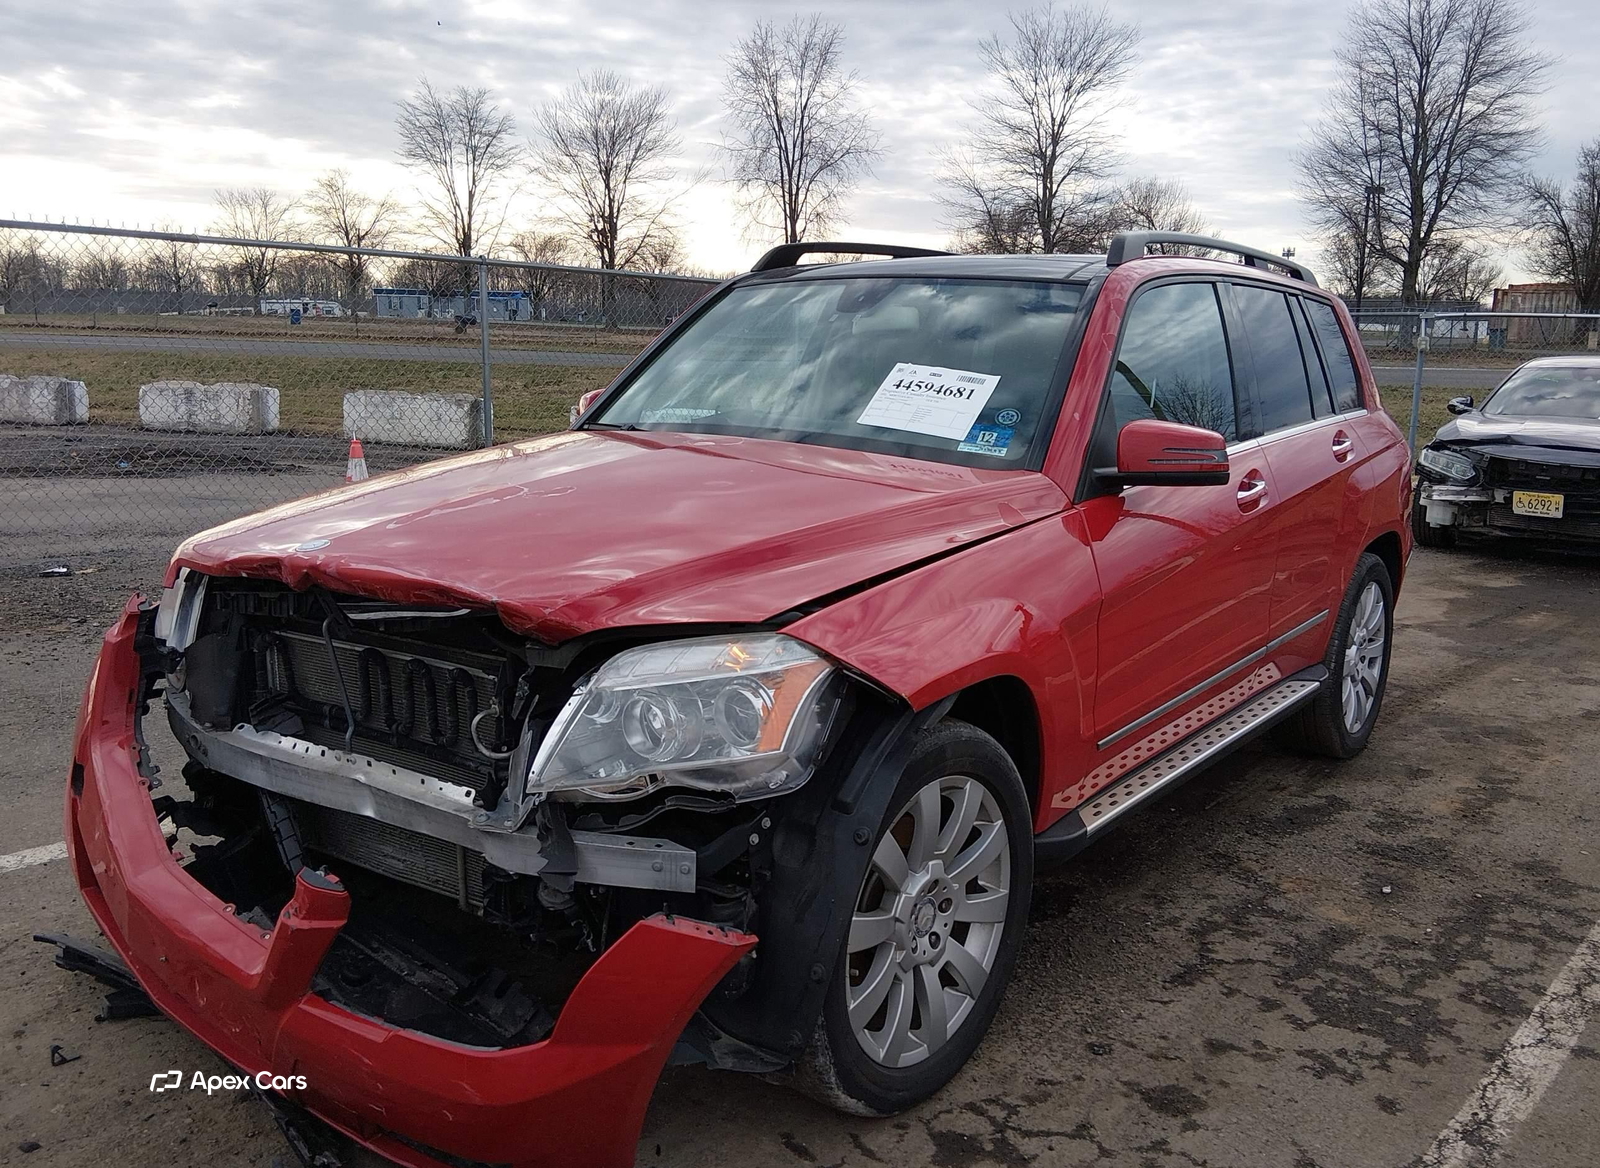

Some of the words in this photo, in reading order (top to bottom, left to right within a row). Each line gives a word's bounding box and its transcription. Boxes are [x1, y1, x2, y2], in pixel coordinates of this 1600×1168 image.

[892, 378, 976, 400] 44594681
[980, 432, 994, 443] 12
[1527, 498, 1552, 511] 6292
